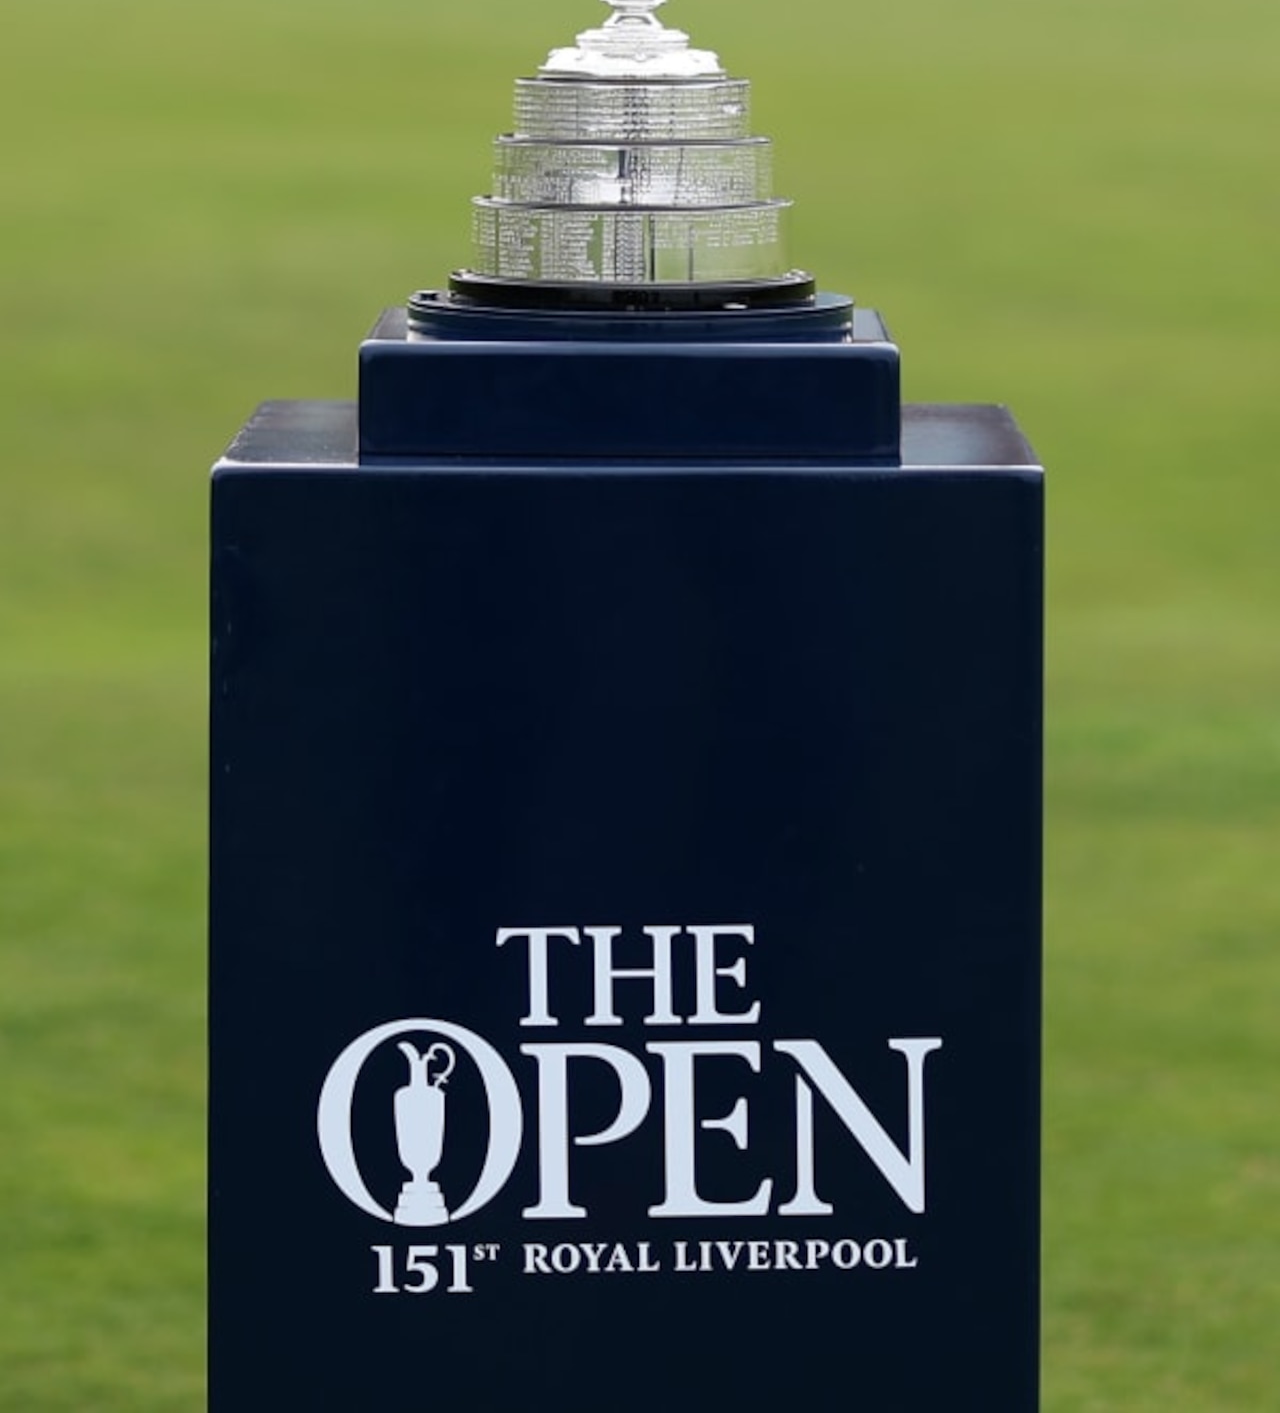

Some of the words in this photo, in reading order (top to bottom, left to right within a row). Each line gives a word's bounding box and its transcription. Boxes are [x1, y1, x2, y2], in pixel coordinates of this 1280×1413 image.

[495, 924, 761, 1026] THE
[317, 1018, 943, 1228] OPEN
[523, 1242, 661, 1274] ROYAL
[673, 1238, 918, 1272] LIVERPOOL
